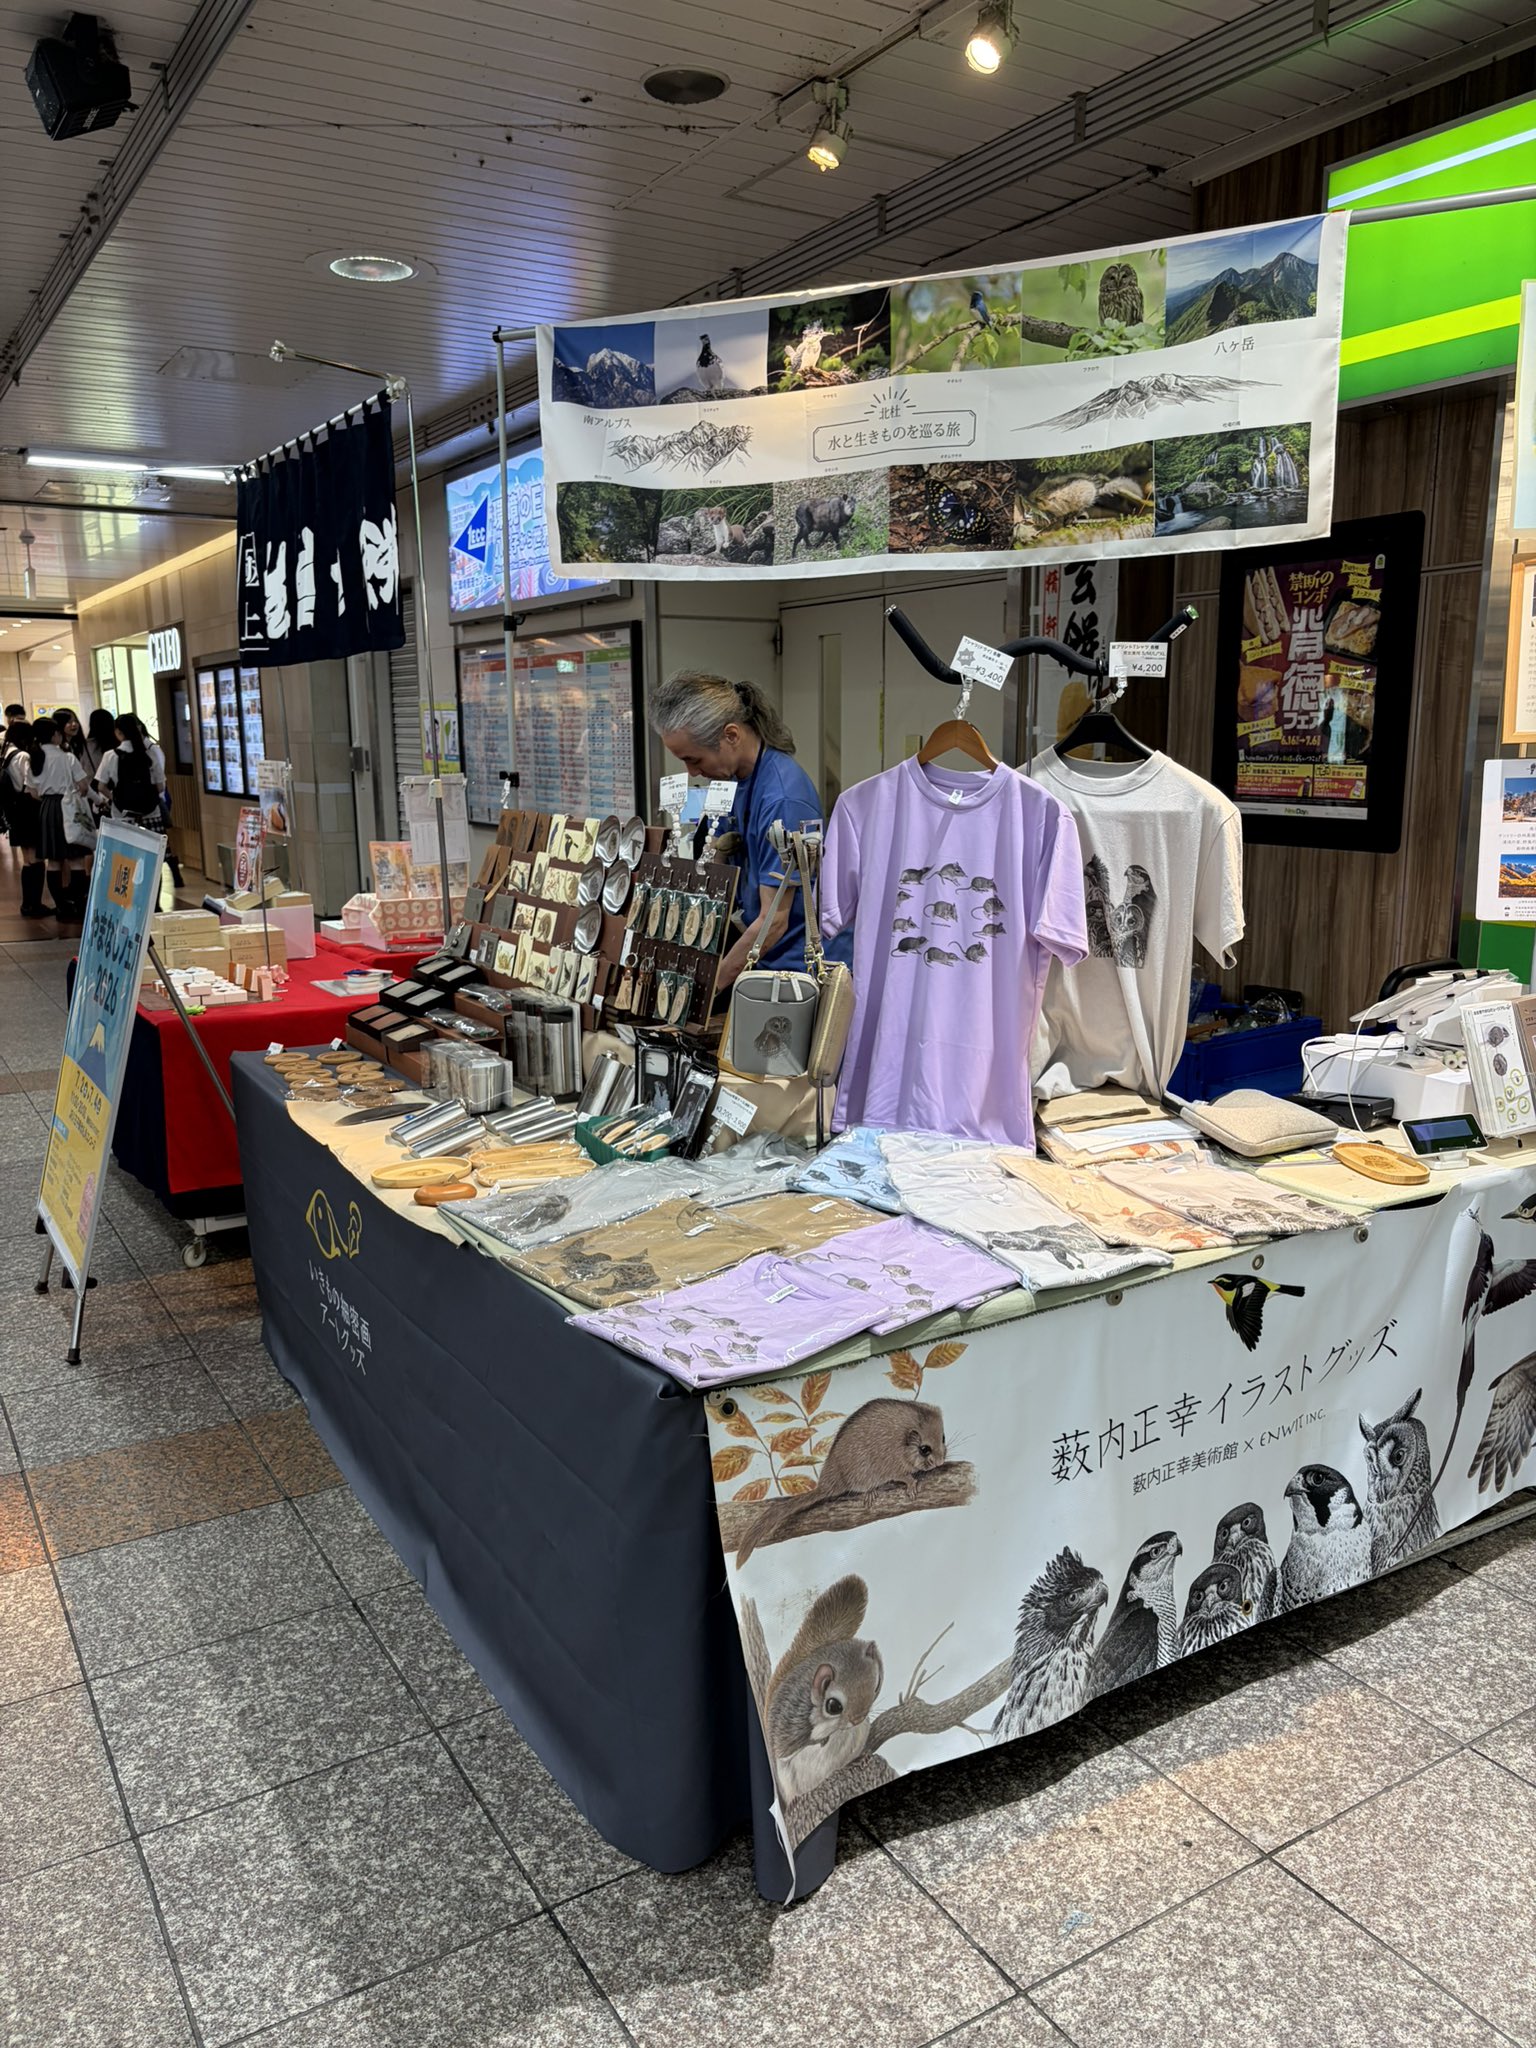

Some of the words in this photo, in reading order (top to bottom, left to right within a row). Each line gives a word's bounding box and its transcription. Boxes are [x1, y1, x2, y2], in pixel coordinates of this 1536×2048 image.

[583, 414, 632, 430] 南アルプス
[879, 404, 901, 421] 北杜
[827, 420, 961, 452] 水と生きものを巡る旅
[1288, 570, 1335, 592] 禁断の
[1292, 586, 1330, 605] コンボ
[149, 627, 182, 674] CELEO
[1132, 663, 1163, 673] ¥4,200
[93, 964, 120, 1017] 2026
[320, 1302, 366, 1376] アートグッズ
